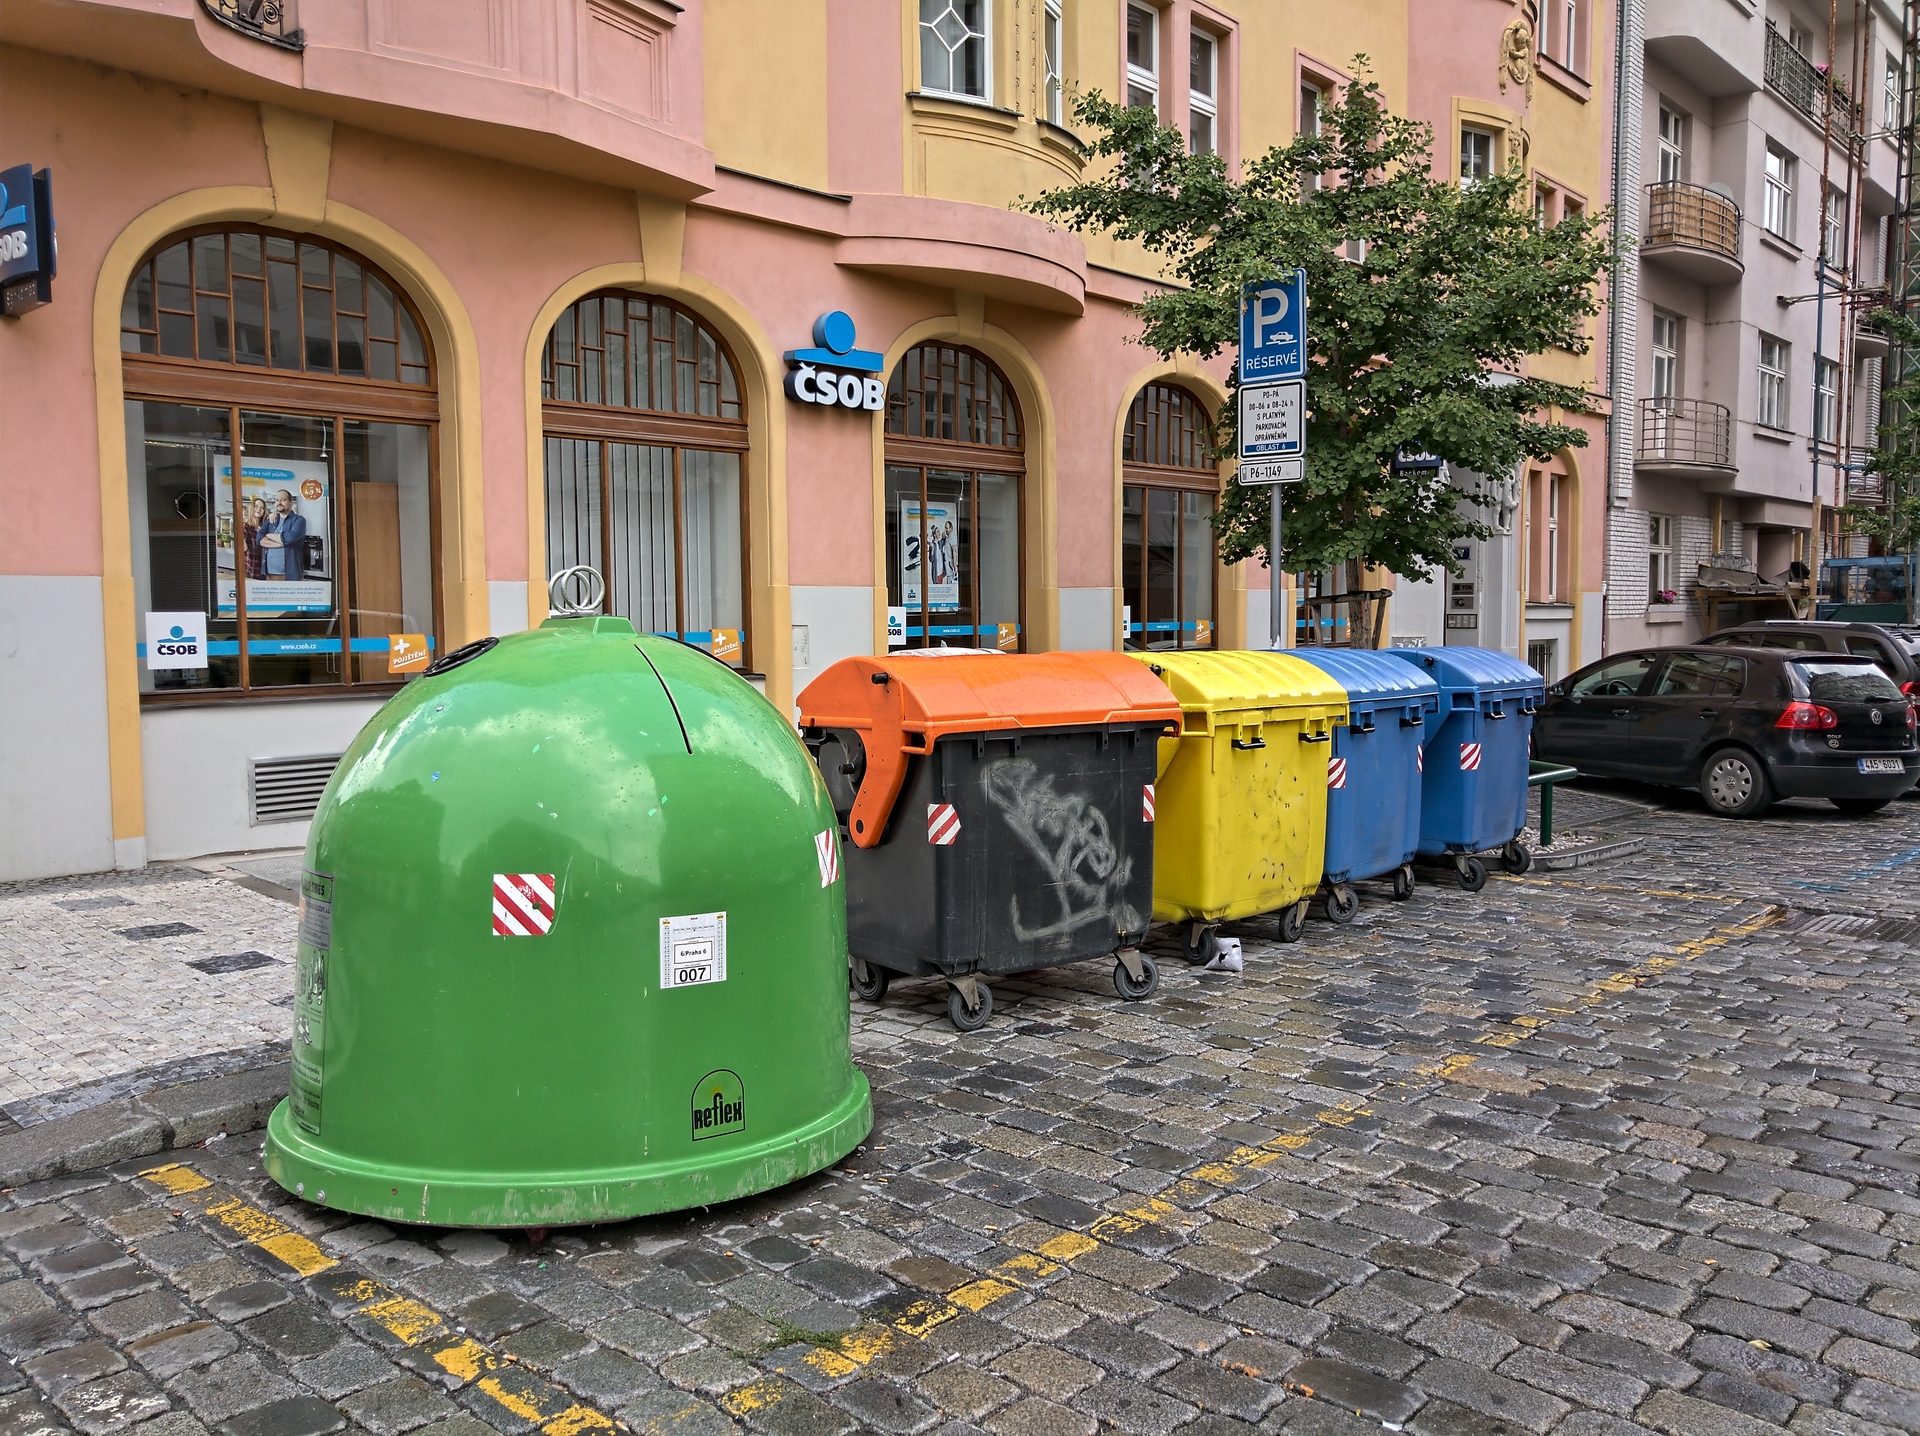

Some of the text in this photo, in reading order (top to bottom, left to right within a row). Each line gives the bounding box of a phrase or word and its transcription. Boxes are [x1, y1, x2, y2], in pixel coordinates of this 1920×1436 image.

[0, 230, 28, 263] OB
[1253, 287, 1289, 349] P
[1246, 349, 1298, 371] RÉSERVÉ
[794, 362, 885, 411] ČSOB
[1262, 388, 1280, 399] PO-PÁ
[1248, 402, 1265, 411] 00-06
[1271, 400, 1288, 409] 08-24
[1289, 399, 1294, 407] h
[1256, 409, 1286, 421] S PLATNÝM
[1255, 420, 1287, 431] PARKOVACÍM
[1254, 430, 1288, 442] OPRÁVNĚNÍM
[1255, 443, 1279, 452] OBLAST
[1250, 465, 1282, 479] P6-1149
[888, 628, 902, 637] SOB
[157, 644, 198, 656] ČSOB
[393, 648, 426, 665] POJIŠTĚNÍ
[679, 967, 707, 983] 007
